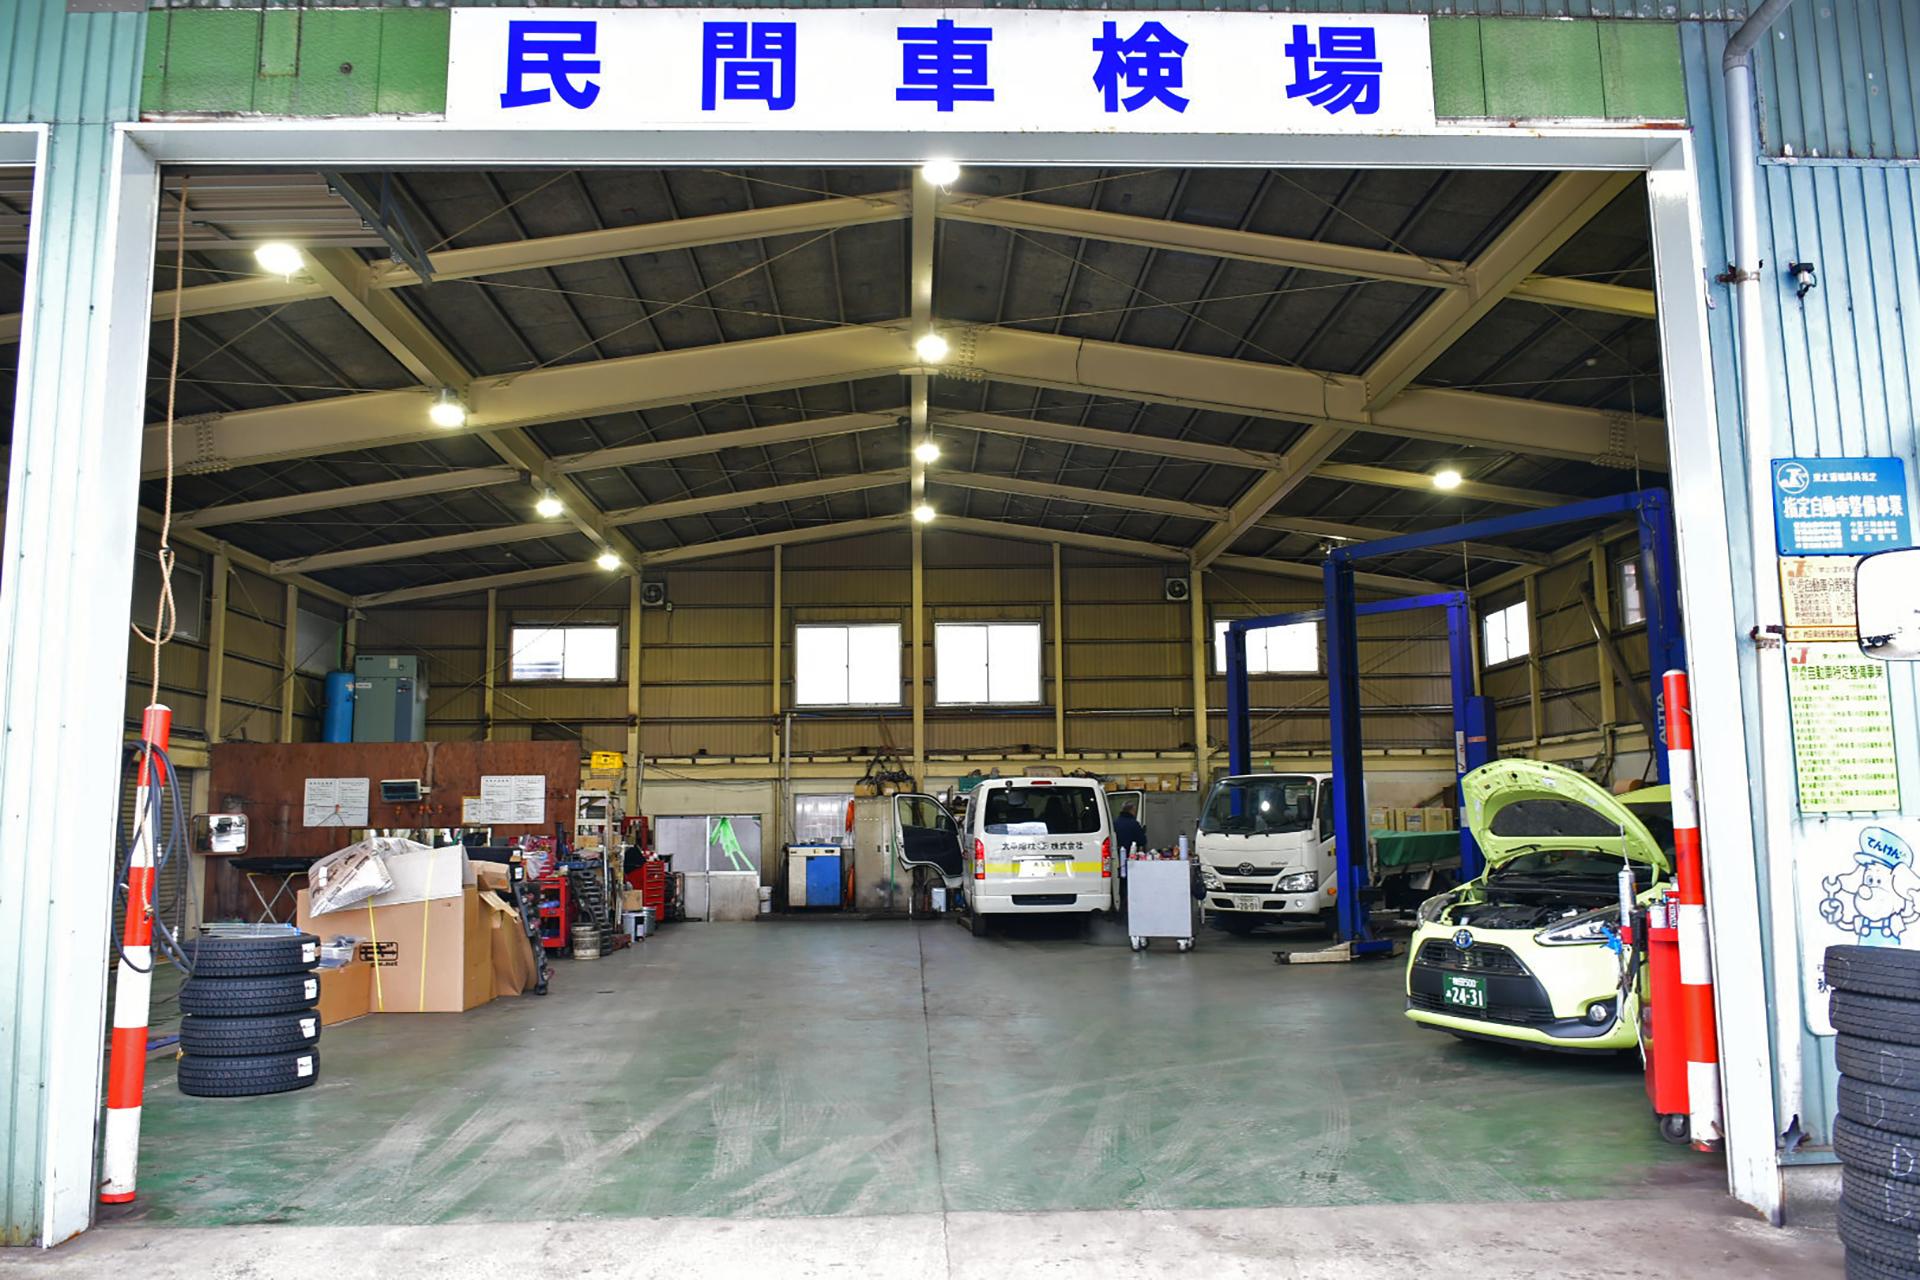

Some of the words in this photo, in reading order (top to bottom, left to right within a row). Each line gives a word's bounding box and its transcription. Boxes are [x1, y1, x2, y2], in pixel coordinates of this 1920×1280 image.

[500, 19, 1382, 114] 民間車検場
[1451, 986, 1483, 1007] 24-31
